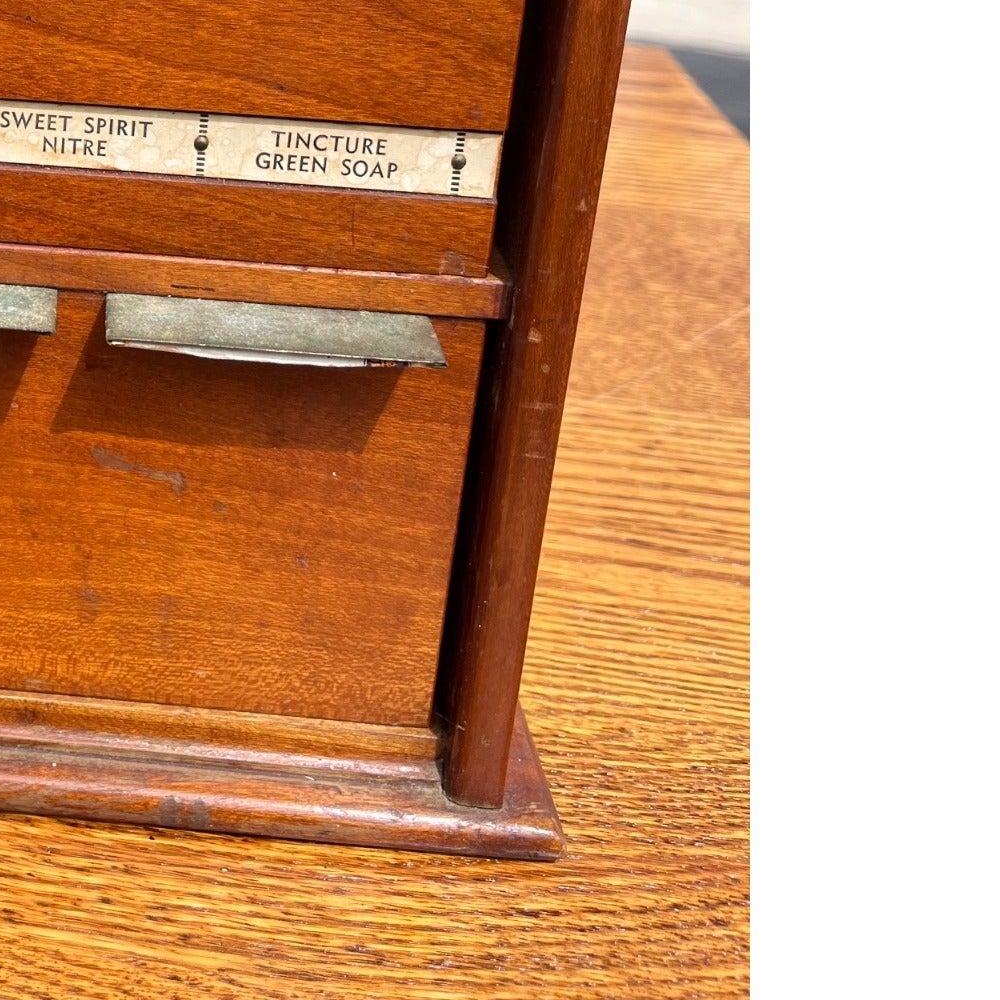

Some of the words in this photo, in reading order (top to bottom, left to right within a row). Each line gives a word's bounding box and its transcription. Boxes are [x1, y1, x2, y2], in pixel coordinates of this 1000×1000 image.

[0, 110, 73, 133] SWEET
[82, 116, 154, 139] SPIRIT
[41, 136, 108, 158] NITRE
[270, 130, 388, 156] TINCTURE
[254, 151, 328, 174] GREEN
[340, 158, 399, 179] SOAP
